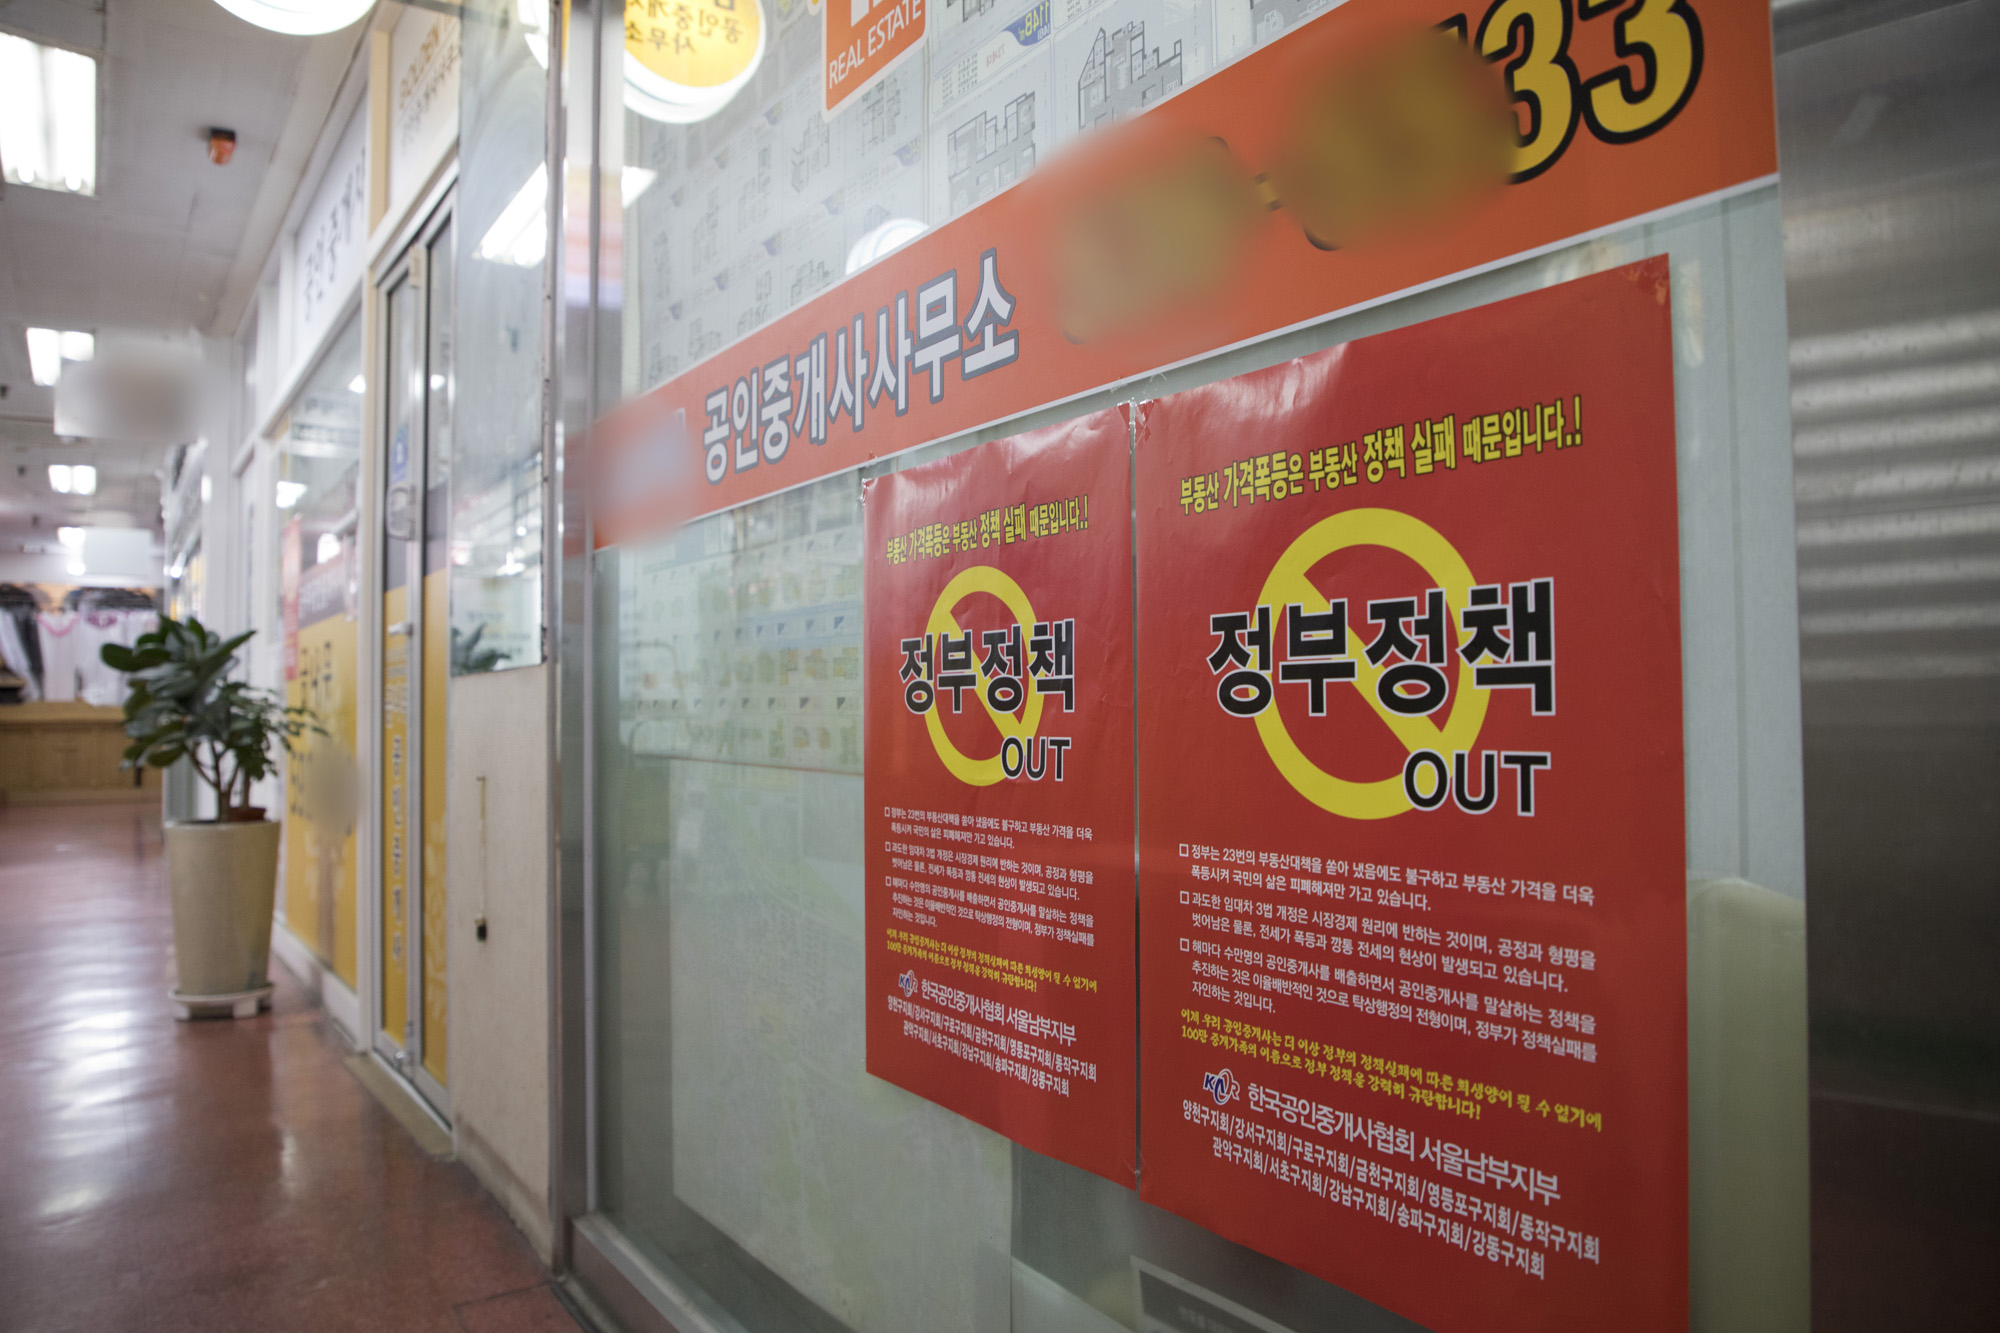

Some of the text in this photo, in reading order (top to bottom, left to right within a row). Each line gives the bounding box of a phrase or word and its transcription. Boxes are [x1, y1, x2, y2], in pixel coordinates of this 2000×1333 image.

[829, 0, 922, 89] REAL ESTATE
[703, 247, 1019, 485] 공인중개사사무소
[1179, 471, 1220, 516] 부동산
[1222, 451, 1305, 509] 가격폭등은
[1307, 440, 1359, 491] 부동산
[1362, 424, 1406, 483] 정책
[1409, 414, 1457, 476] 실패
[886, 535, 908, 565] 부동산
[908, 522, 951, 561] 가격폭등은
[952, 519, 978, 553] 부동산
[979, 509, 1001, 549] 정책
[1002, 503, 1027, 544] 실패
[899, 618, 1075, 714] 정부정책
[1206, 577, 1556, 717] 정부정책
[1001, 735, 1071, 781] OUT
[1403, 748, 1551, 817] OUT
[1191, 844, 1220, 861] 정부는
[1222, 847, 1255, 865] 23번의
[1258, 851, 1322, 874] 부동산대책을
[1352, 862, 1401, 882] 냈음에도
[1405, 867, 1458, 889] 불구하고
[1462, 874, 1506, 896] 부동산
[1511, 879, 1557, 902] 가격을
[1562, 884, 1595, 906] 더욱
[1191, 864, 1431, 911] 폭등시켜 국민의 삶은 피폐해져만 가고 있습니다.
[1191, 892, 1596, 970] 과도한 임대차 3법 개정은 시장경제 원리에 반하는 것이며, 공정과 형평을
[1192, 912, 1568, 992] 벗어남은 물론, 전세가 폭등과 깡통 전세의 현상이 발생되고 있습니다.
[921, 978, 1077, 1047] 한국공인중개사협회 서울남부지부
[1191, 960, 1597, 1063] 추진하는 것은 이율배반적인 것으로 탁상행정의 전형이며, 정부가 정책실패를
[1192, 939, 1596, 1034] 해마다 수만명의 공인중개사를 배출하면서 공인중개사를 말살하는 정책을
[1192, 980, 1276, 1013] 자인하는 것입니다.
[1180, 1008, 1199, 1025] 이제
[1202, 1013, 1220, 1030] 우리
[1223, 1018, 1282, 1047] 공인중개사는
[1284, 1034, 1294, 1051] 더
[1297, 1038, 1320, 1057] 이상
[1322, 1044, 1356, 1067] 정부의
[1360, 1053, 1422, 1084] 정책실패에
[1426, 1071, 1453, 1091] 따른
[1456, 1078, 1512, 1108] 희생양이
[1535, 1099, 1551, 1118] 수
[1554, 1103, 1602, 1132] 없기에
[1181, 1024, 1481, 1120] 100만 중개가족의 이름으로 정부 정책을 강력히 규탄합니다!
[1247, 1082, 1561, 1206] 한국공인중개사협회 서울남부지부
